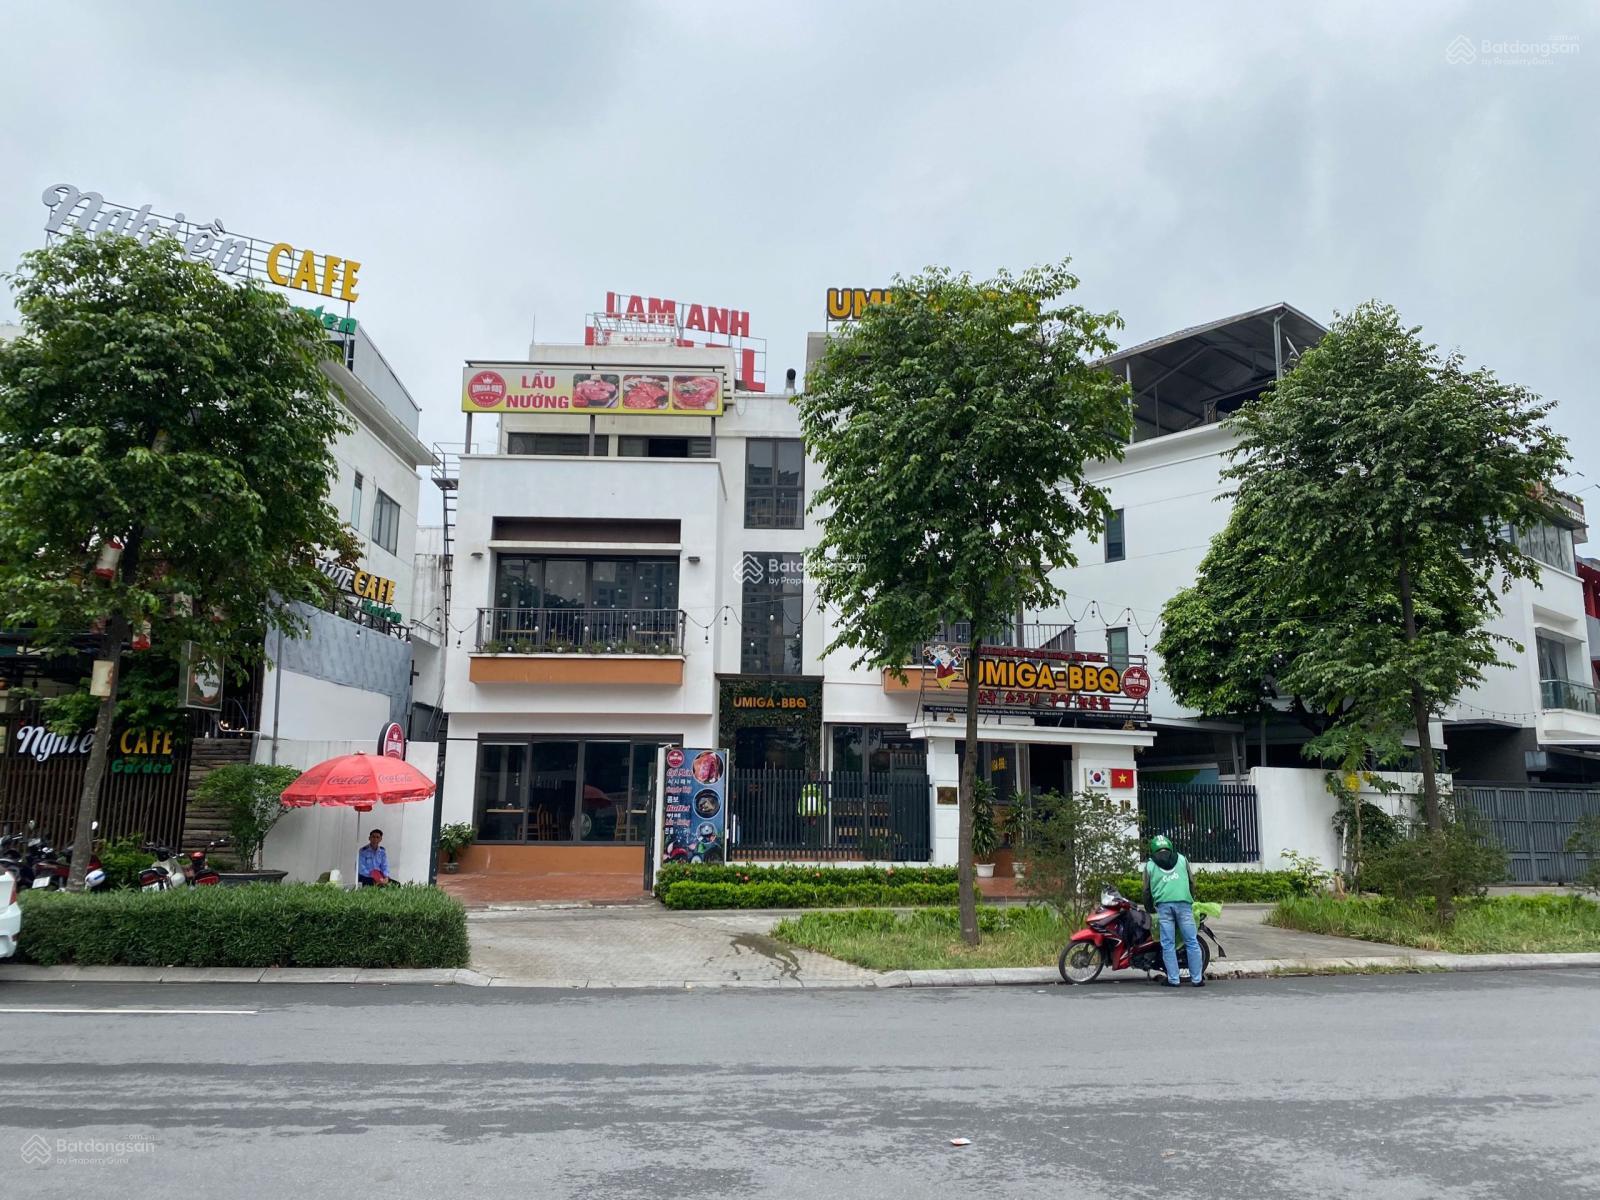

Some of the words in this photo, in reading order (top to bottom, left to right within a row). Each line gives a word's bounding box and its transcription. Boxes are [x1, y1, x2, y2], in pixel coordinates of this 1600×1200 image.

[267, 242, 361, 303] CAFE
[686, 303, 749, 337] ANH
[521, 370, 555, 389] LẨU
[506, 393, 569, 409] NƯỚNG
[353, 570, 396, 605] CAFE
[120, 728, 173, 755] CAFE
[111, 759, 173, 774] Garden
